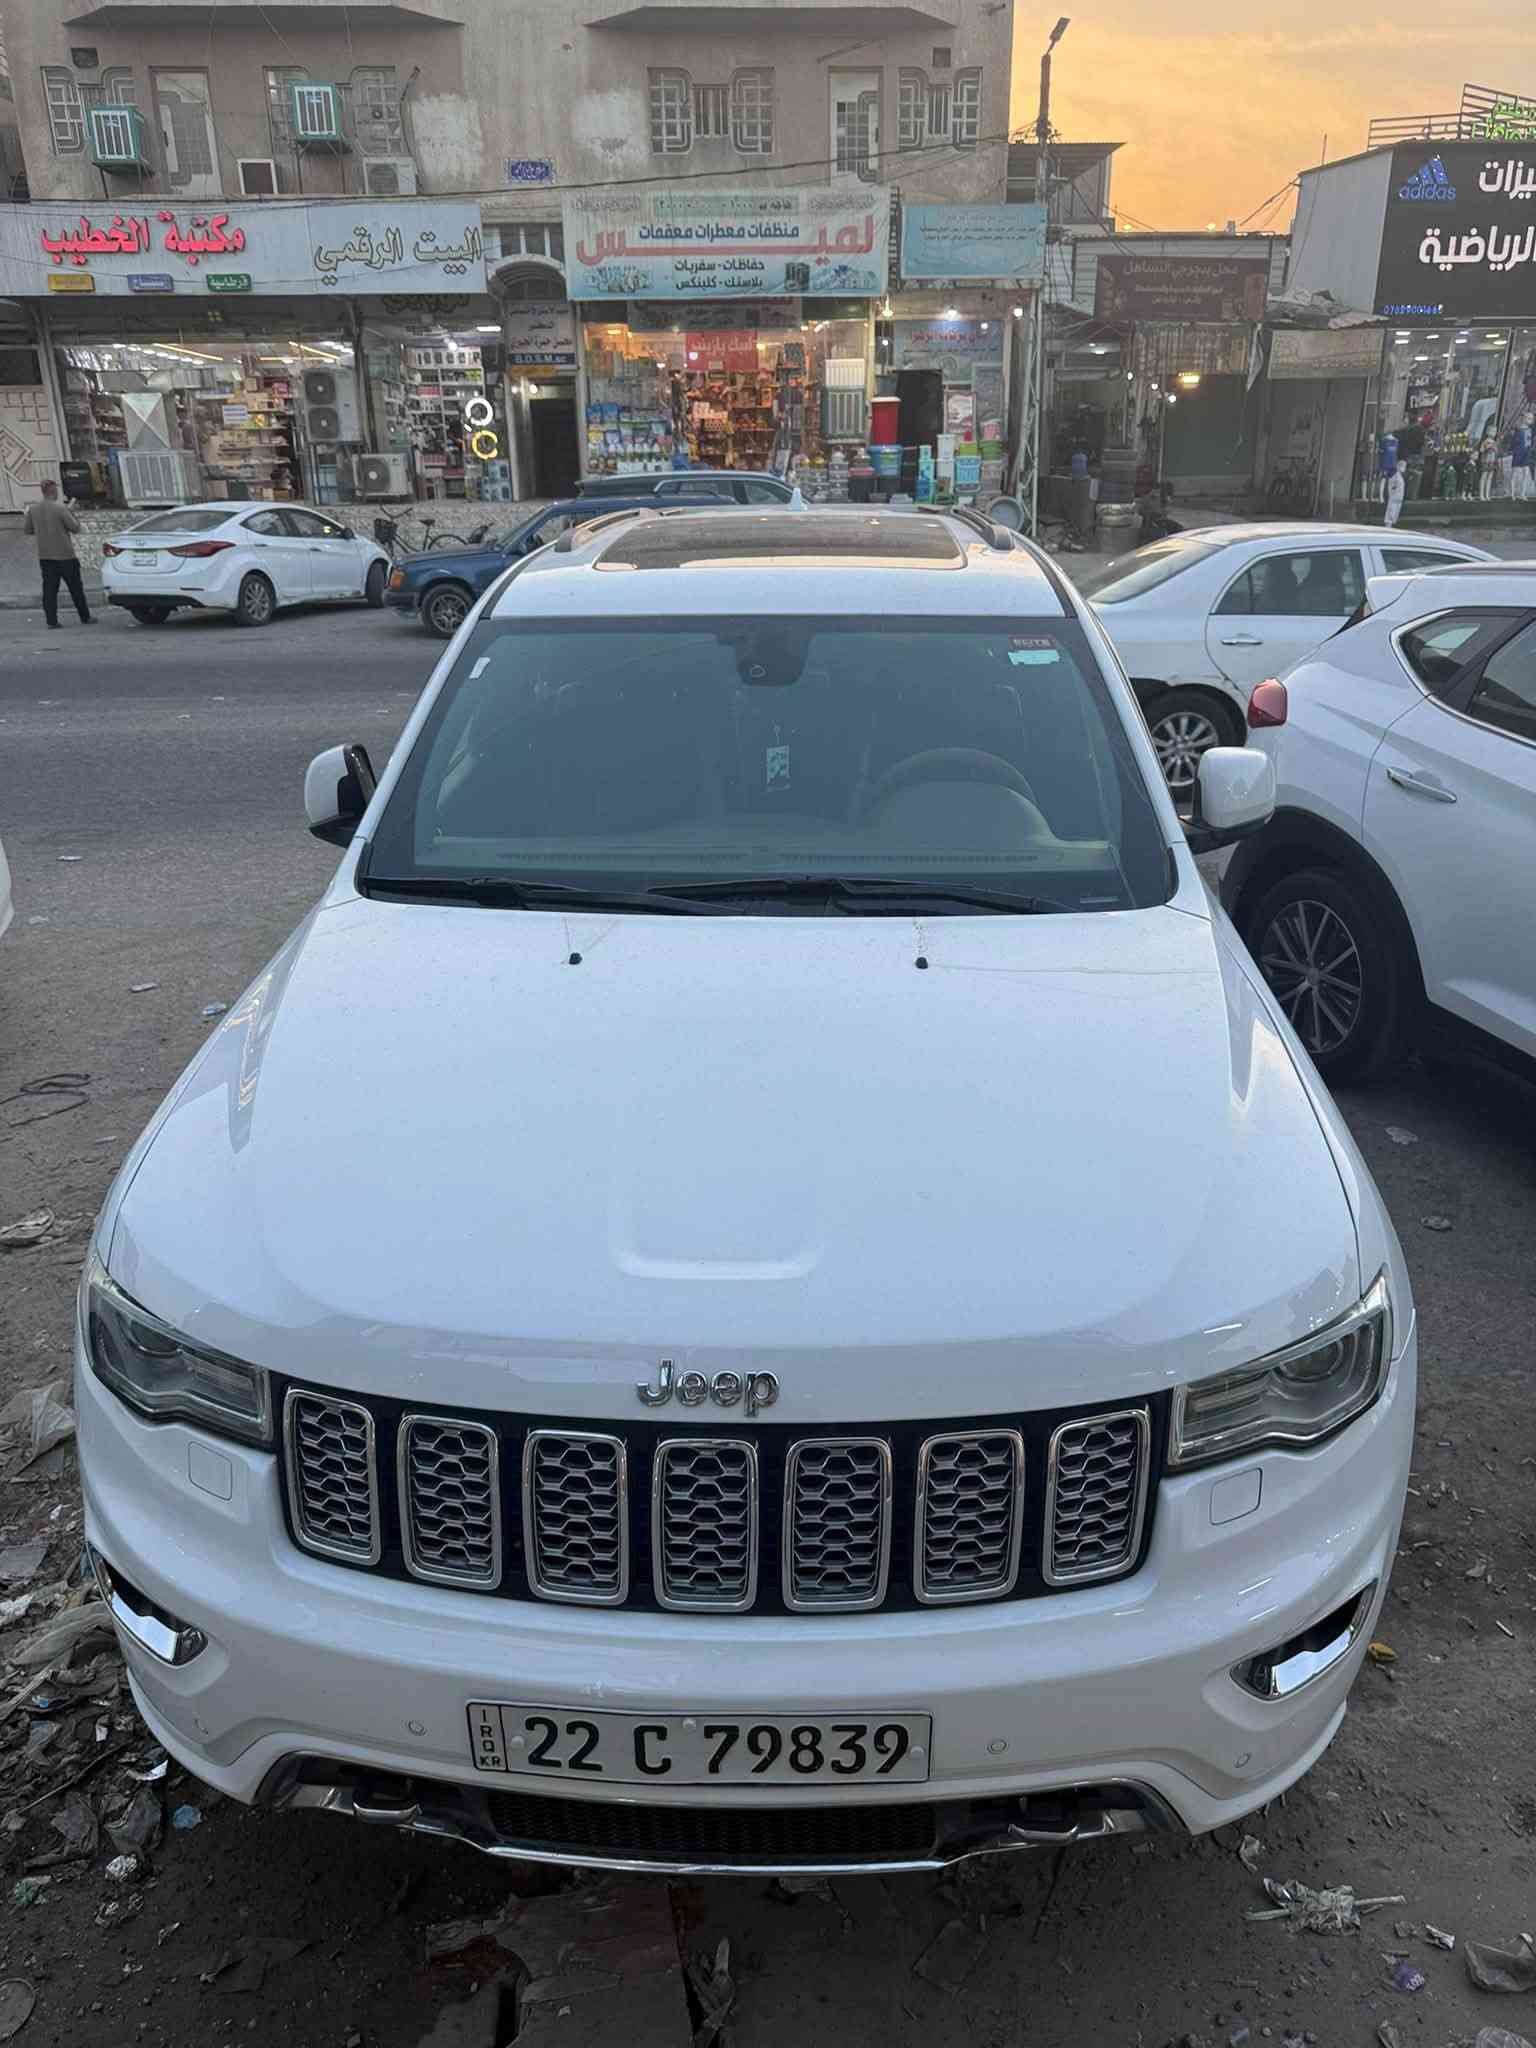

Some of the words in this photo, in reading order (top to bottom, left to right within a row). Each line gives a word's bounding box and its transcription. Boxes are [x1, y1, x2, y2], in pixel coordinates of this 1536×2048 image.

[1400, 184, 1456, 200] adidas
[1479, 159, 1536, 200] يزات
[41, 214, 150, 266] الخطيب
[157, 210, 246, 267] مكتبة
[414, 226, 482, 275] البيت
[639, 223, 693, 240] معقمات
[695, 223, 745, 243] معطرات
[748, 223, 800, 239] منظفات
[1418, 225, 1536, 272] لرياضية
[314, 226, 403, 286] الرقمي
[675, 259, 716, 275] سفريات
[723, 258, 765, 271] حفاظات
[636, 1358, 780, 1418] Jeep
[479, 1755, 501, 1768] KR
[525, 1716, 603, 1772] 22
[633, 1724, 672, 1775] C
[703, 1724, 909, 1775] 79839
